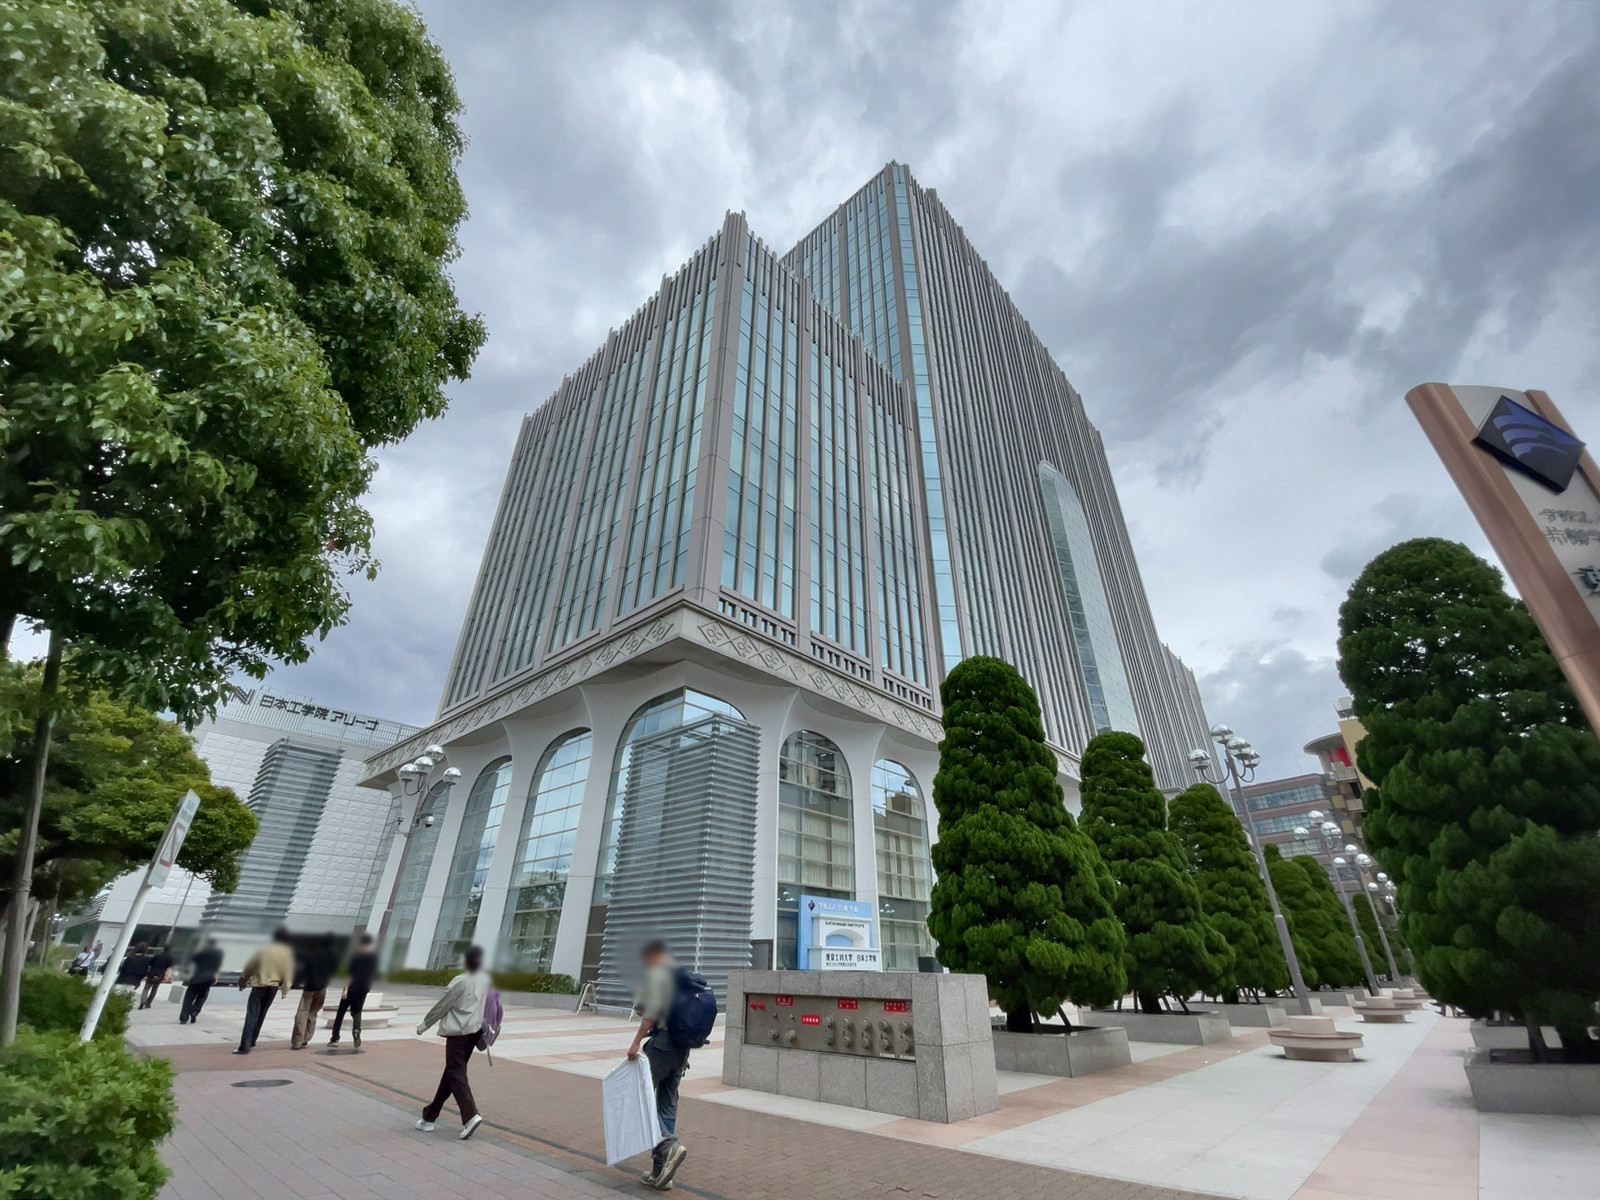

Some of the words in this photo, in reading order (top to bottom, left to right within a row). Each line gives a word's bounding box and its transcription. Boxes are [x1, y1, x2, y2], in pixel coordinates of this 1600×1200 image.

[259, 694, 330, 721] 日本工学院
[330, 710, 380, 731] アリーナ
